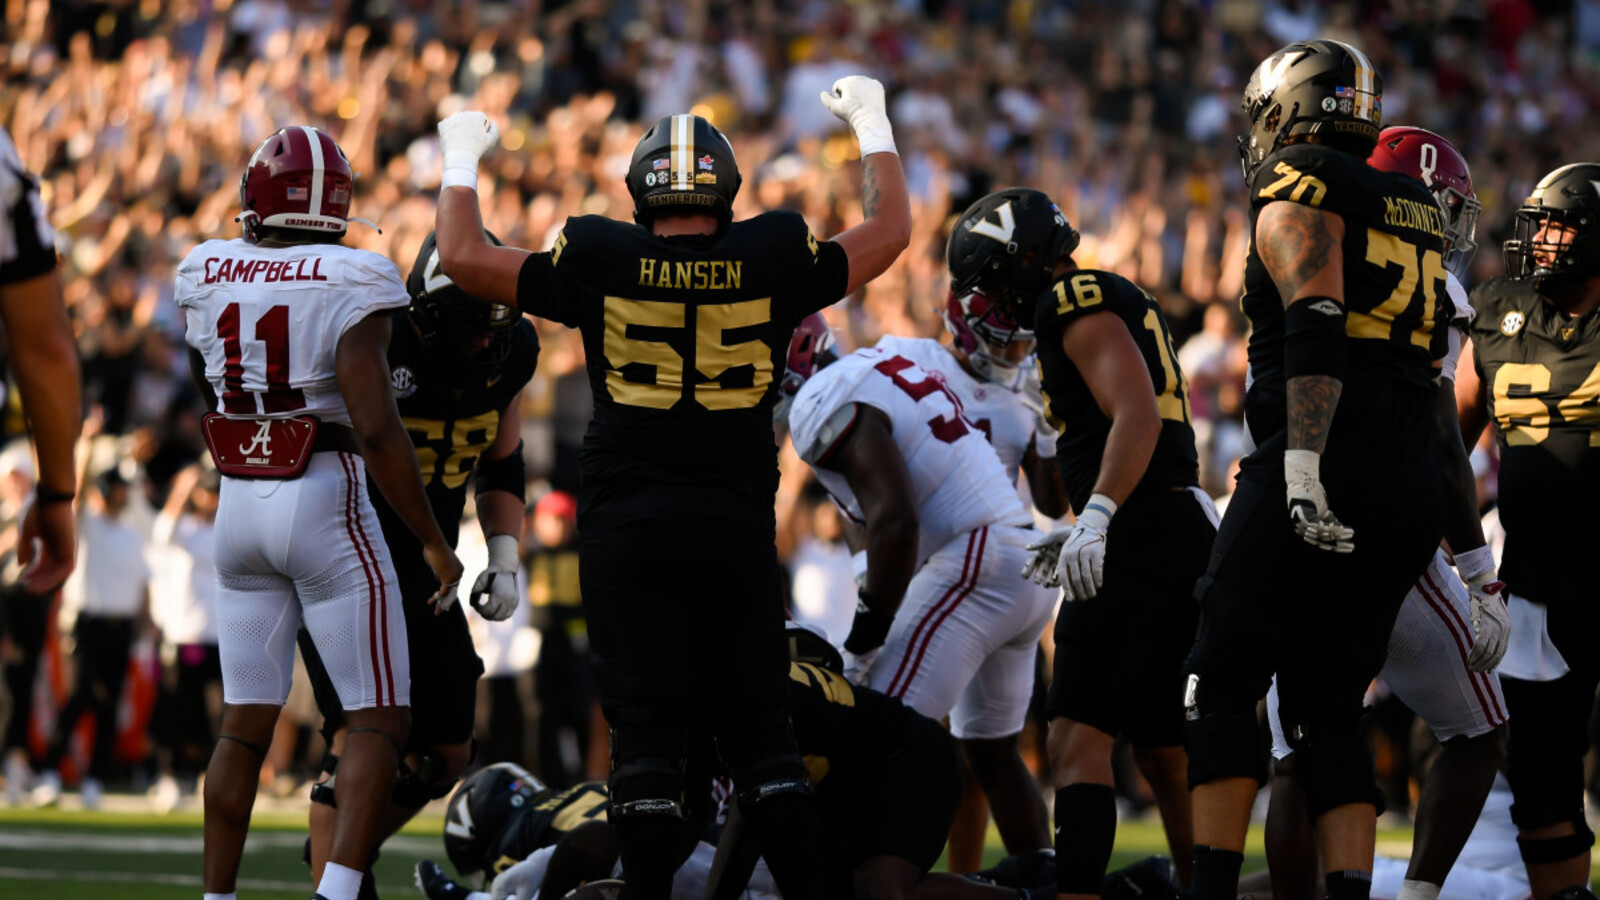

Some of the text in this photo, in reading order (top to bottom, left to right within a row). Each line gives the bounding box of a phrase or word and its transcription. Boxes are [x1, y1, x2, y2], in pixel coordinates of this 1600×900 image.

[1258, 161, 1327, 207] 70
[285, 218, 325, 227] CRIMSON
[970, 201, 1016, 244] V
[204, 256, 328, 284] CAMPBELL
[638, 257, 743, 290] HANSEN
[1052, 274, 1103, 315] 16
[216, 302, 307, 415] 11
[603, 295, 774, 411] 55
[392, 367, 412, 389] SEC
[635, 803, 671, 811] DONJOY
